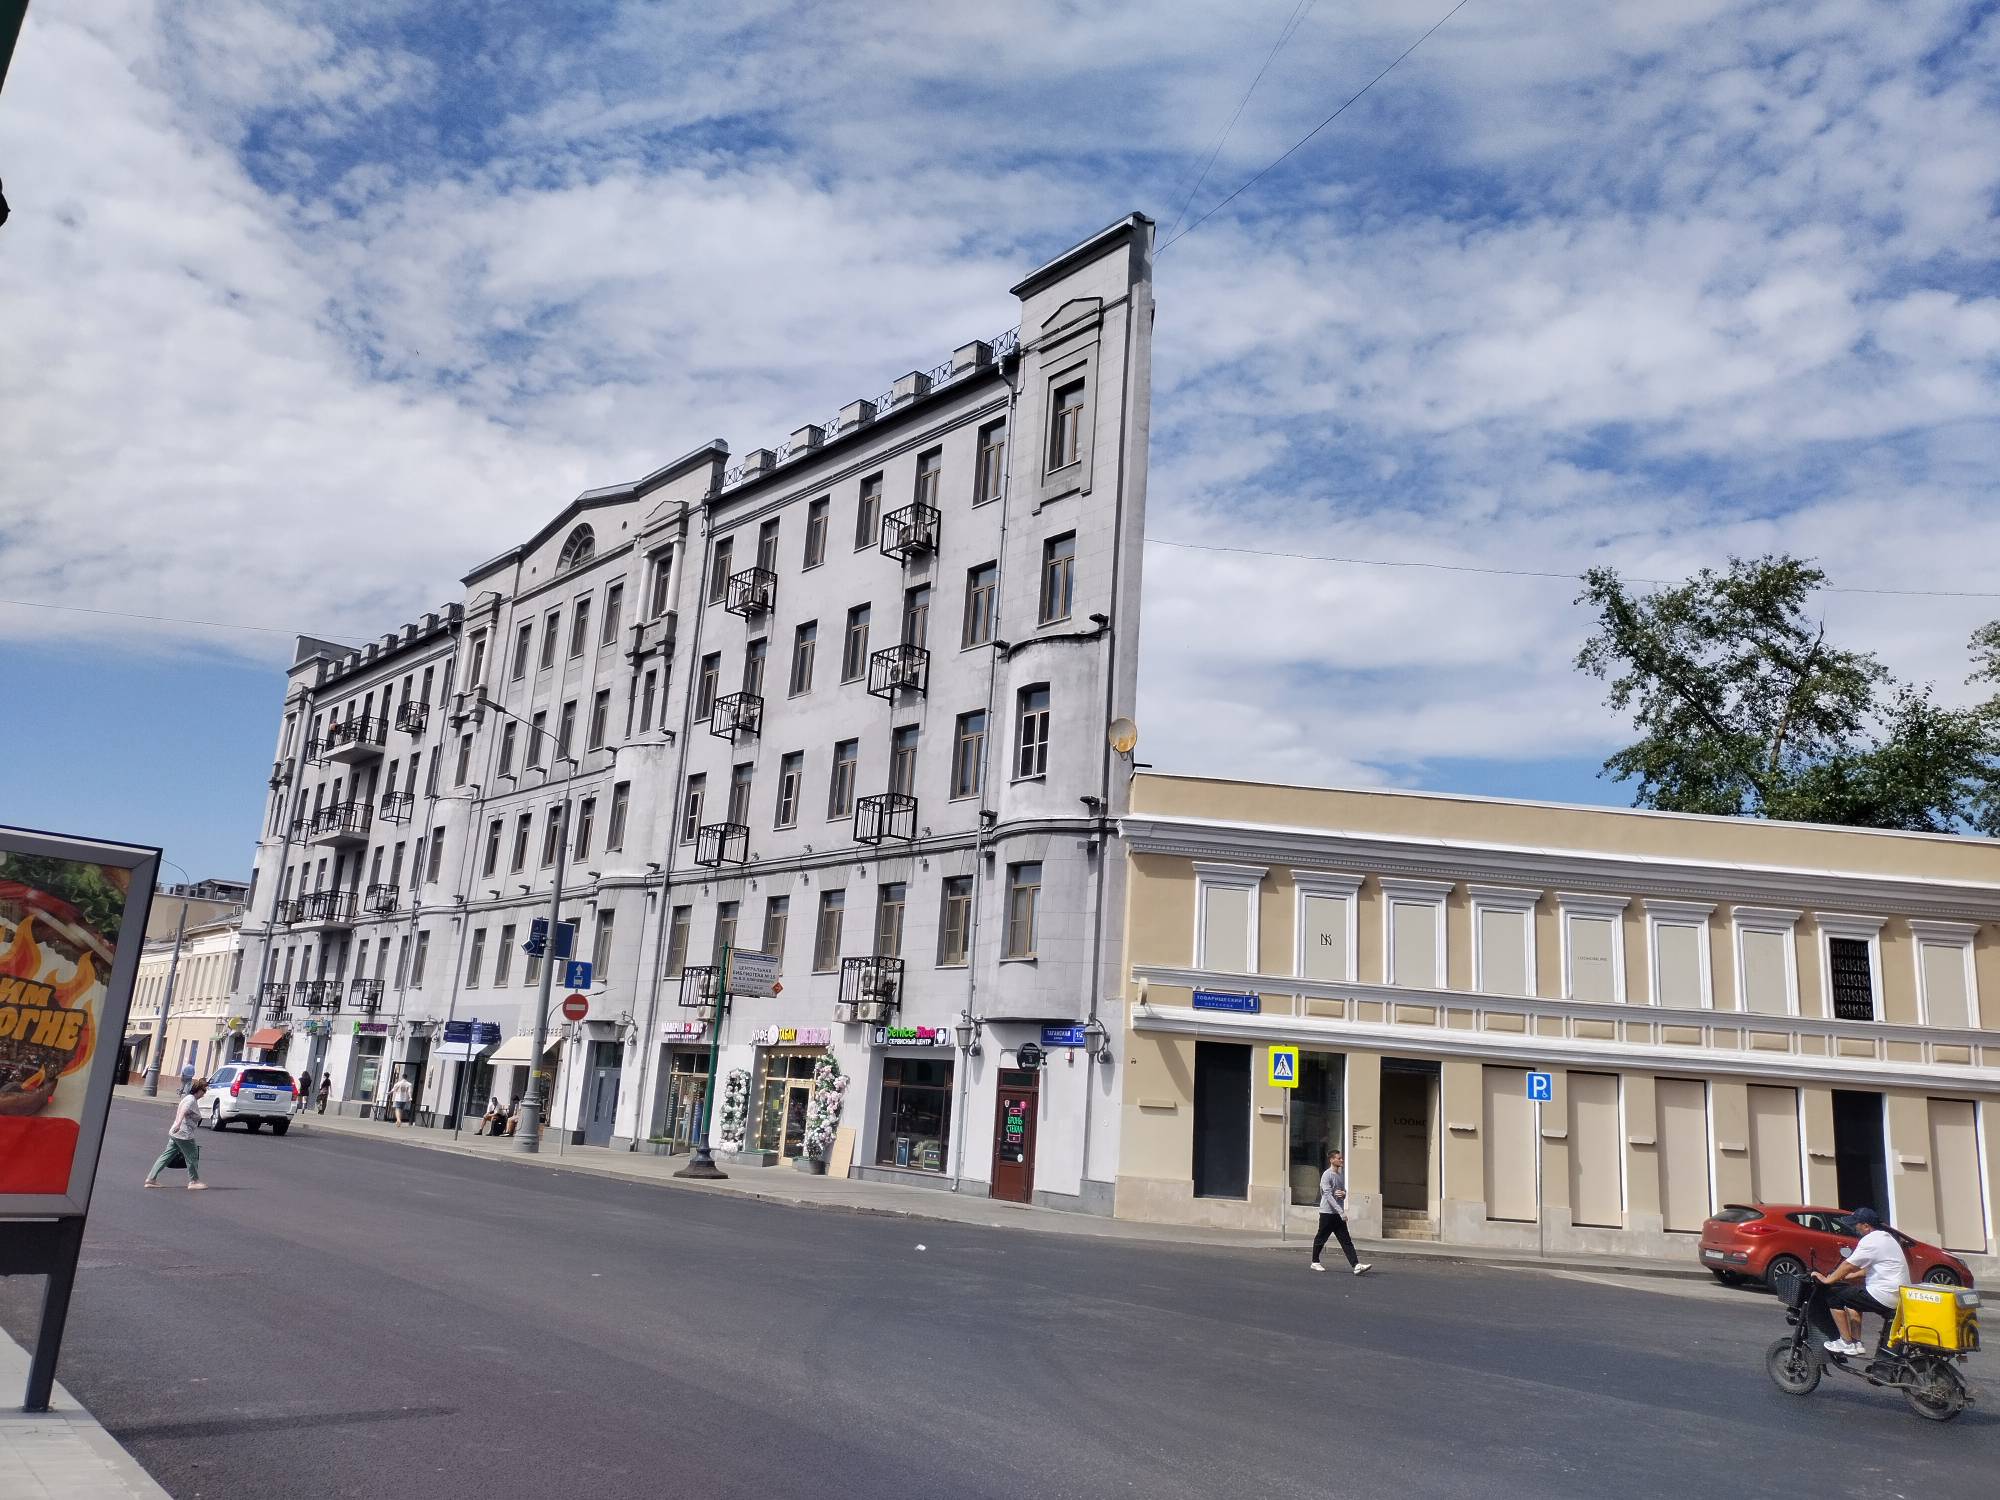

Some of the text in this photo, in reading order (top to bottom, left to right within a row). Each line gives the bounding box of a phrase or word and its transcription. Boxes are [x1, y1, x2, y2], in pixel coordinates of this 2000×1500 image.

[1196, 994, 1254, 1007] ТОВАРИЩЕСКИЙ 1
[0, 1006, 84, 1051] ОГНЕ
[752, 1028, 768, 1041] КОФЕ
[888, 1037, 932, 1046] СЕРВИСНЫЙ ЦЕНТР
[1533, 1075, 1547, 1098] P
[1007, 1116, 1023, 1125] БРОНЬ
